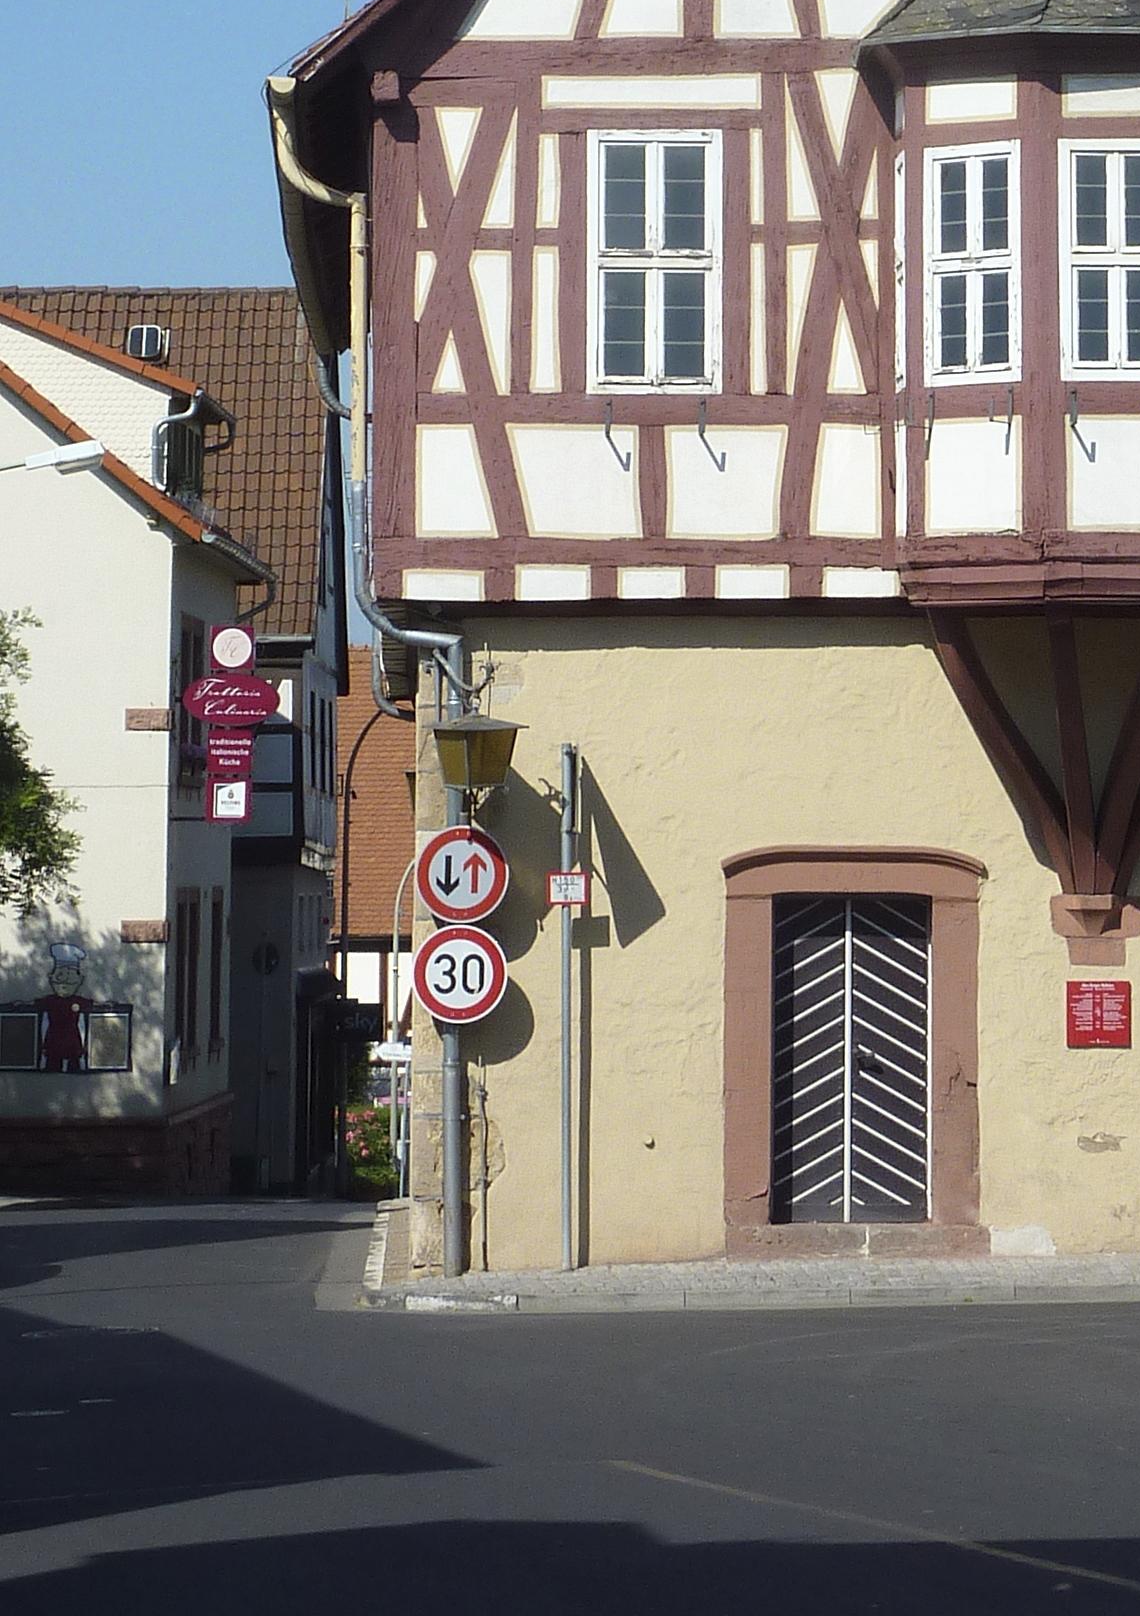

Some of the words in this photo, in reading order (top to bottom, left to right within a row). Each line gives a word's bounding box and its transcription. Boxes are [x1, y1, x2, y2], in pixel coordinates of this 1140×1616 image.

[192, 678, 261, 701] Trattoria
[204, 699, 267, 716] Culinaria
[209, 738, 252, 746] traditionelle
[218, 758, 241, 766] Küche
[433, 953, 485, 995] 30
[344, 1012, 377, 1034] sky
